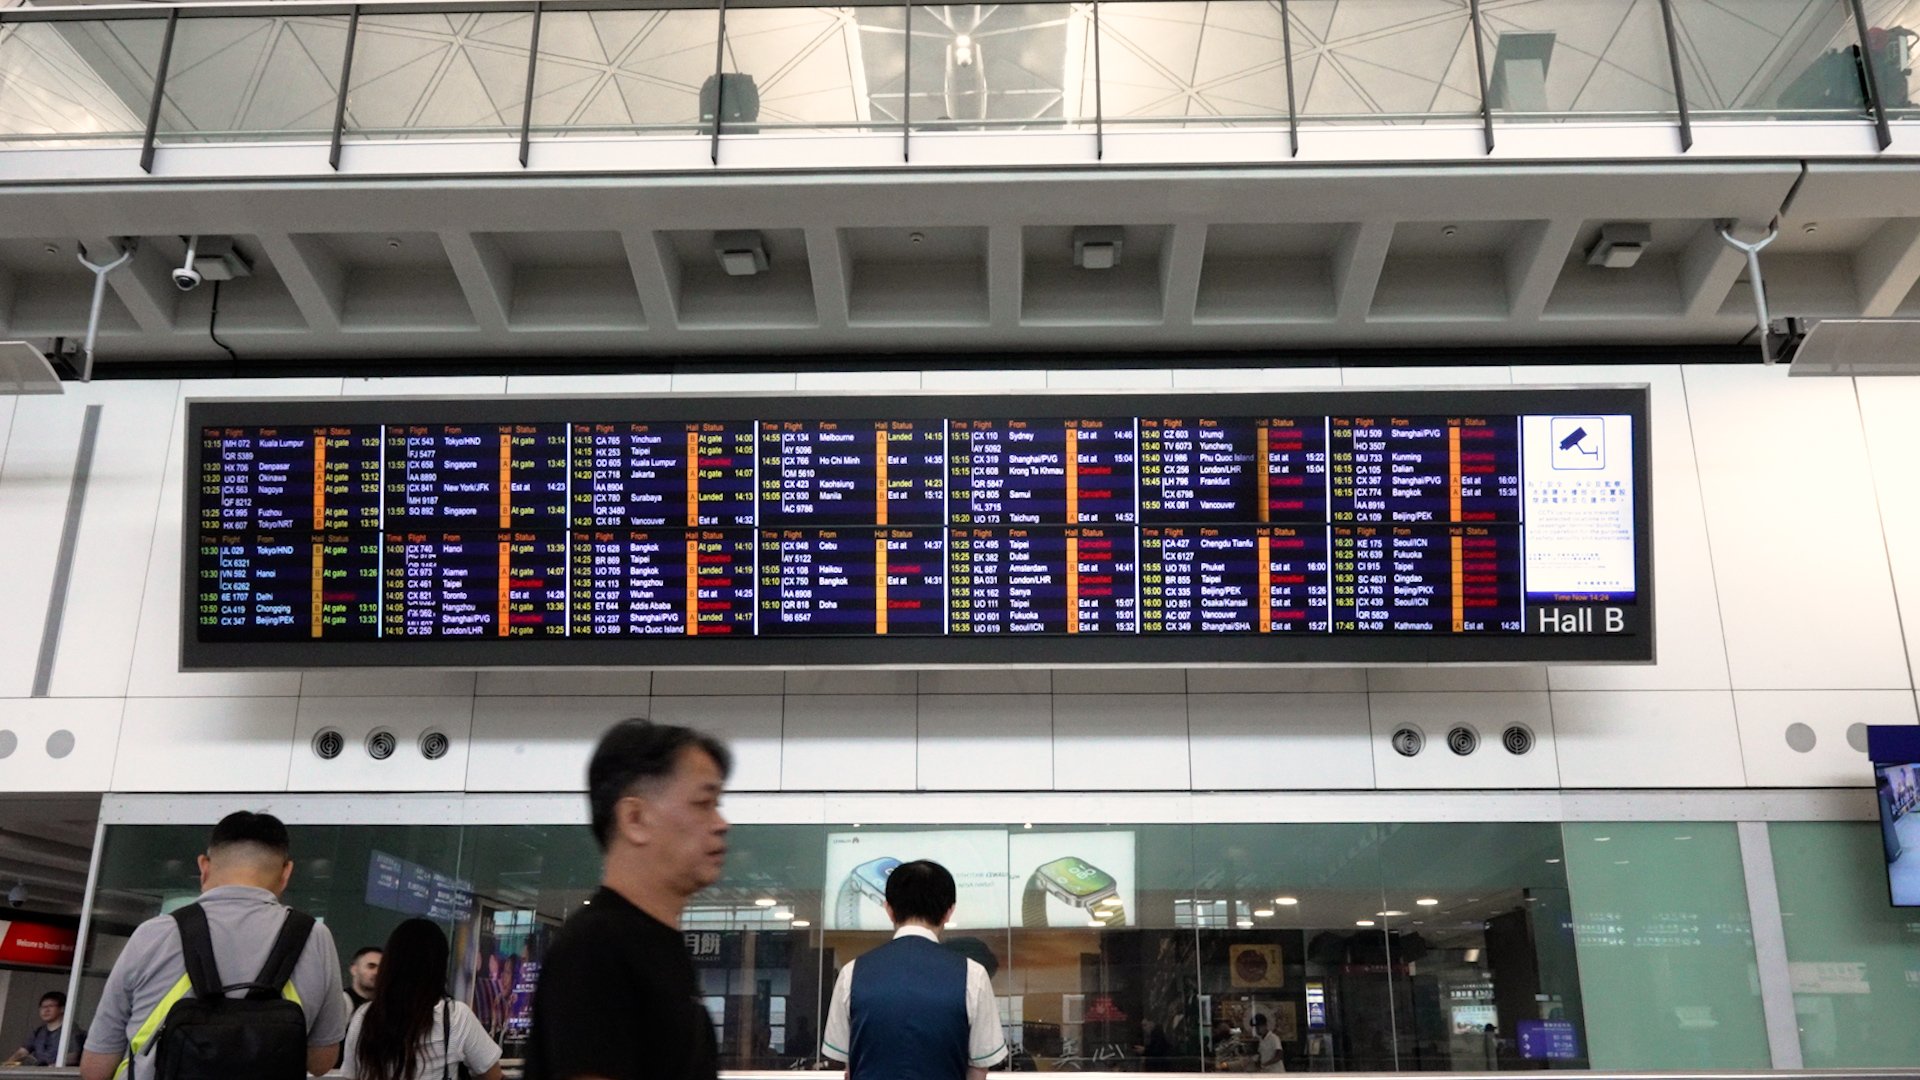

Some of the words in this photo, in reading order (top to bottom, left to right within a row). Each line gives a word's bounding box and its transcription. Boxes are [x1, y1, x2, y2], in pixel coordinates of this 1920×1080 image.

[1009, 432, 1034, 441] Sydney
[1199, 431, 1224, 440] Urumqi
[1392, 430, 1440, 440] Shanghai/PVG
[279, 440, 304, 449] Lumpur
[444, 437, 481, 446] Tokyo/HND
[631, 436, 662, 444] Yinchuan
[631, 447, 650, 456] Taipei
[1199, 442, 1233, 452] Yuncheng
[831, 457, 842, 465] Chi
[844, 457, 860, 465] Minh
[1009, 455, 1058, 465] Shanghai/PVG
[1200, 454, 1214, 462] Phu
[1215, 454, 1233, 462] Quoc
[1392, 453, 1422, 462] Kunming
[258, 462, 290, 471] Denpasar
[444, 461, 477, 470] Singapore
[651, 459, 676, 468] Lumpur
[1009, 467, 1029, 476] Krong
[1040, 467, 1064, 475] Khmau
[1200, 466, 1241, 474] London/LHR
[1392, 464, 1414, 473] Dalian
[888, 480, 912, 488] Landed
[1200, 477, 1230, 486] Frankfurt
[1392, 476, 1441, 485] Shanghai/PVG
[460, 484, 489, 492] York/JFK
[819, 481, 854, 490] Kaohsiung
[258, 486, 284, 495] Nagoya
[1009, 490, 1031, 498] Samui
[1392, 488, 1422, 497] Bangkok
[631, 494, 662, 503] Surabaya
[699, 493, 723, 501] Landed
[819, 492, 842, 500] Manila
[1200, 501, 1235, 509] Vancouver
[335, 510, 348, 518] gate
[444, 507, 477, 516] Singapore
[1009, 514, 1040, 523] Taichung
[1392, 512, 1432, 521] Beijing/PEK
[258, 520, 293, 529] Tokyo/NRT
[819, 542, 838, 550] Cebu
[1009, 541, 1029, 550] Taipei
[1200, 540, 1231, 550] Chengdu
[1232, 539, 1253, 548] Tianfu
[1393, 538, 1428, 547] Seoul/ICN
[257, 546, 294, 555] Tokyo/HND
[443, 545, 462, 553] Hanoi
[630, 543, 659, 552] Bangkok
[630, 555, 650, 564] Taipei
[1009, 552, 1029, 560] Dubai
[1393, 551, 1422, 559] Fukuoka
[698, 566, 723, 574] Landed
[819, 566, 843, 574] Haikou
[1009, 564, 1047, 572] Amsterdam
[1201, 563, 1225, 571] Phuket
[1394, 562, 1414, 571] Taipei
[256, 570, 276, 578] Hanoi
[443, 568, 468, 576] Xiamen
[630, 567, 659, 576] Bangkok
[630, 578, 663, 588] Hangzhou
[819, 577, 848, 586] Bangkok
[1009, 576, 1051, 584] London/LHR
[1201, 575, 1221, 584] Taipei
[1394, 574, 1422, 583] Qingdao
[443, 580, 462, 589] Taipei
[630, 590, 654, 598] Wuhan
[1009, 588, 1031, 597] Sanya
[1201, 587, 1241, 596] Beijing/PEK
[1394, 586, 1434, 596] Beijing/PKX
[256, 593, 273, 601] Delhi
[443, 592, 467, 600] Toronto
[630, 602, 649, 610] Addis
[650, 602, 671, 610] Ababa
[819, 601, 838, 609] Doha
[1010, 599, 1030, 608] Taipei
[1201, 598, 1248, 607] Osaka/Kansai
[1394, 598, 1428, 606] Seoul/ICN
[256, 605, 291, 614] Chongqing
[443, 603, 476, 613] Hangzhou
[443, 615, 490, 624] Shanghai/PVG
[630, 613, 678, 623] Shanghai/PVG
[698, 613, 723, 621] Landed
[1010, 611, 1038, 620] Fukuoka
[1202, 611, 1237, 619] Vancouver
[1540, 607, 1592, 632] Hall
[1605, 607, 1624, 632] B
[256, 616, 294, 625] Beijing/PEK
[443, 626, 483, 635] London/LHR
[630, 625, 644, 634] Phu
[645, 625, 662, 634] Quoc
[664, 625, 684, 634] Island
[1010, 623, 1044, 632] Seoul/ICN
[1202, 622, 1250, 632] Shanghai/SHA
[1394, 622, 1433, 630] Kathmandu
[16, 939, 38, 948] Welcome
